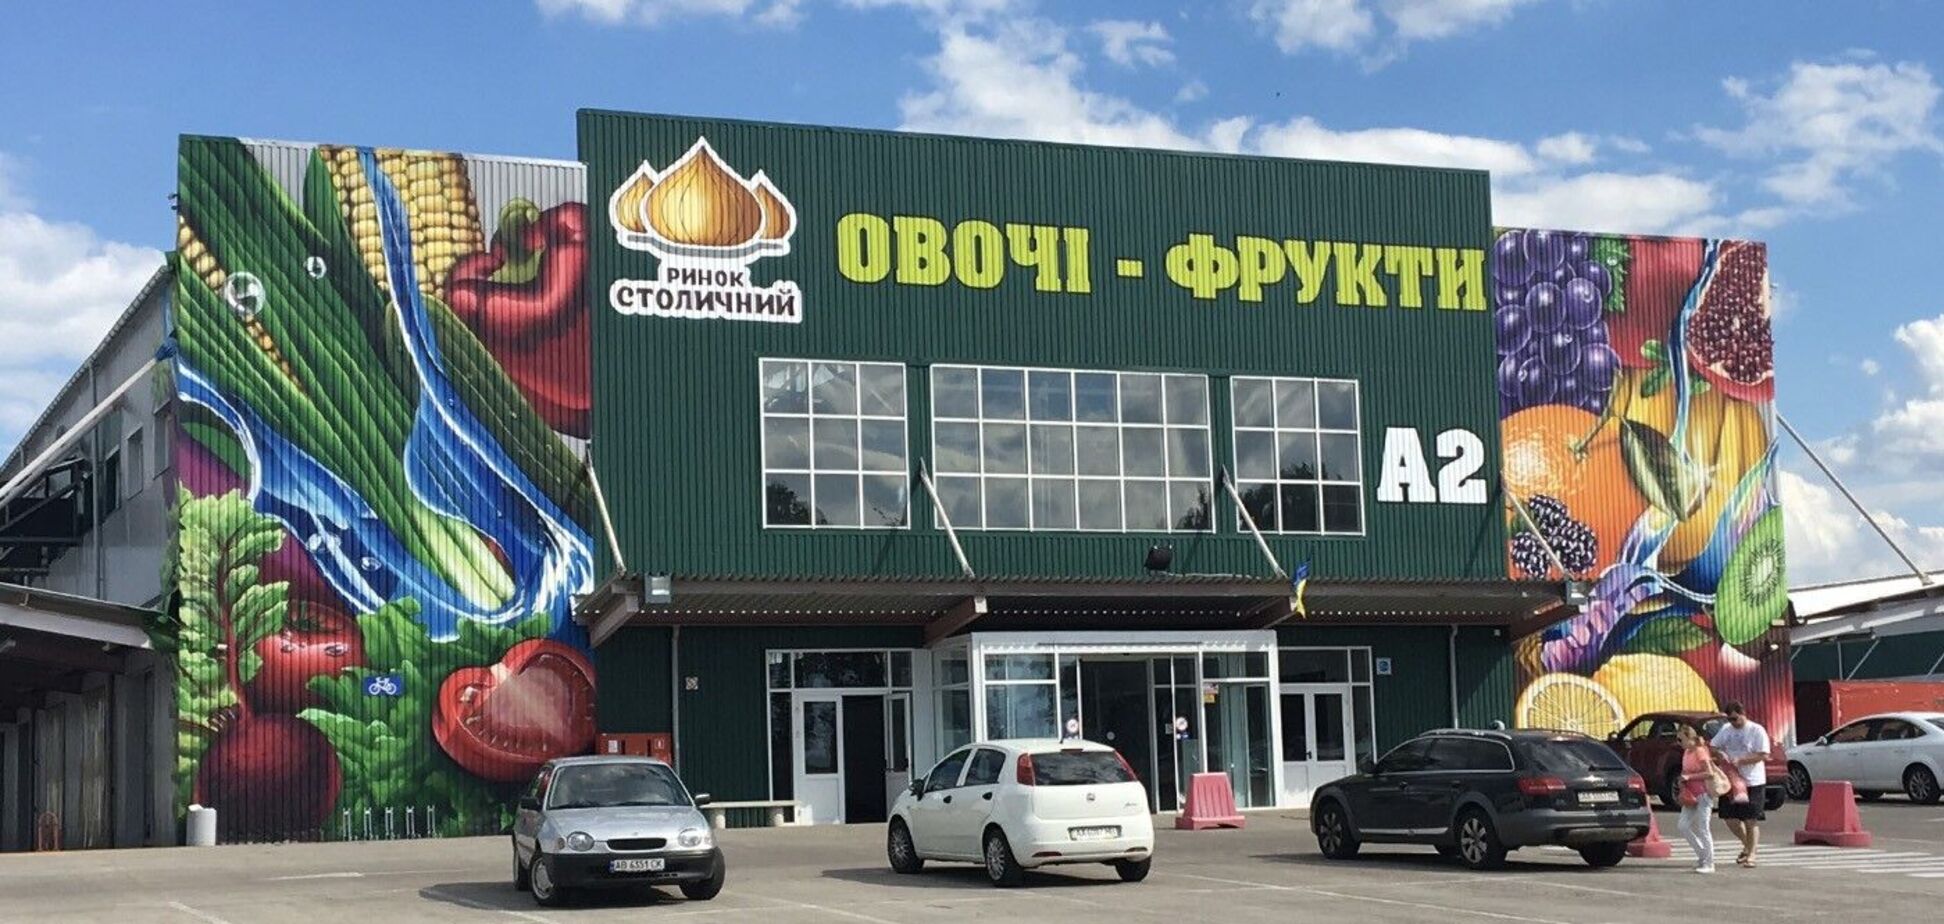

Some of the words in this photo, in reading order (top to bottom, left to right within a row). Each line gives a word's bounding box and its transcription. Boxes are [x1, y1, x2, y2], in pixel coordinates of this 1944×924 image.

[666, 267, 745, 287] РИНОК
[837, 212, 1092, 293] ОВОЧІ
[1165, 233, 1487, 311] ФРУКТИ
[616, 286, 796, 317] СТОЛИЧНИЙ
